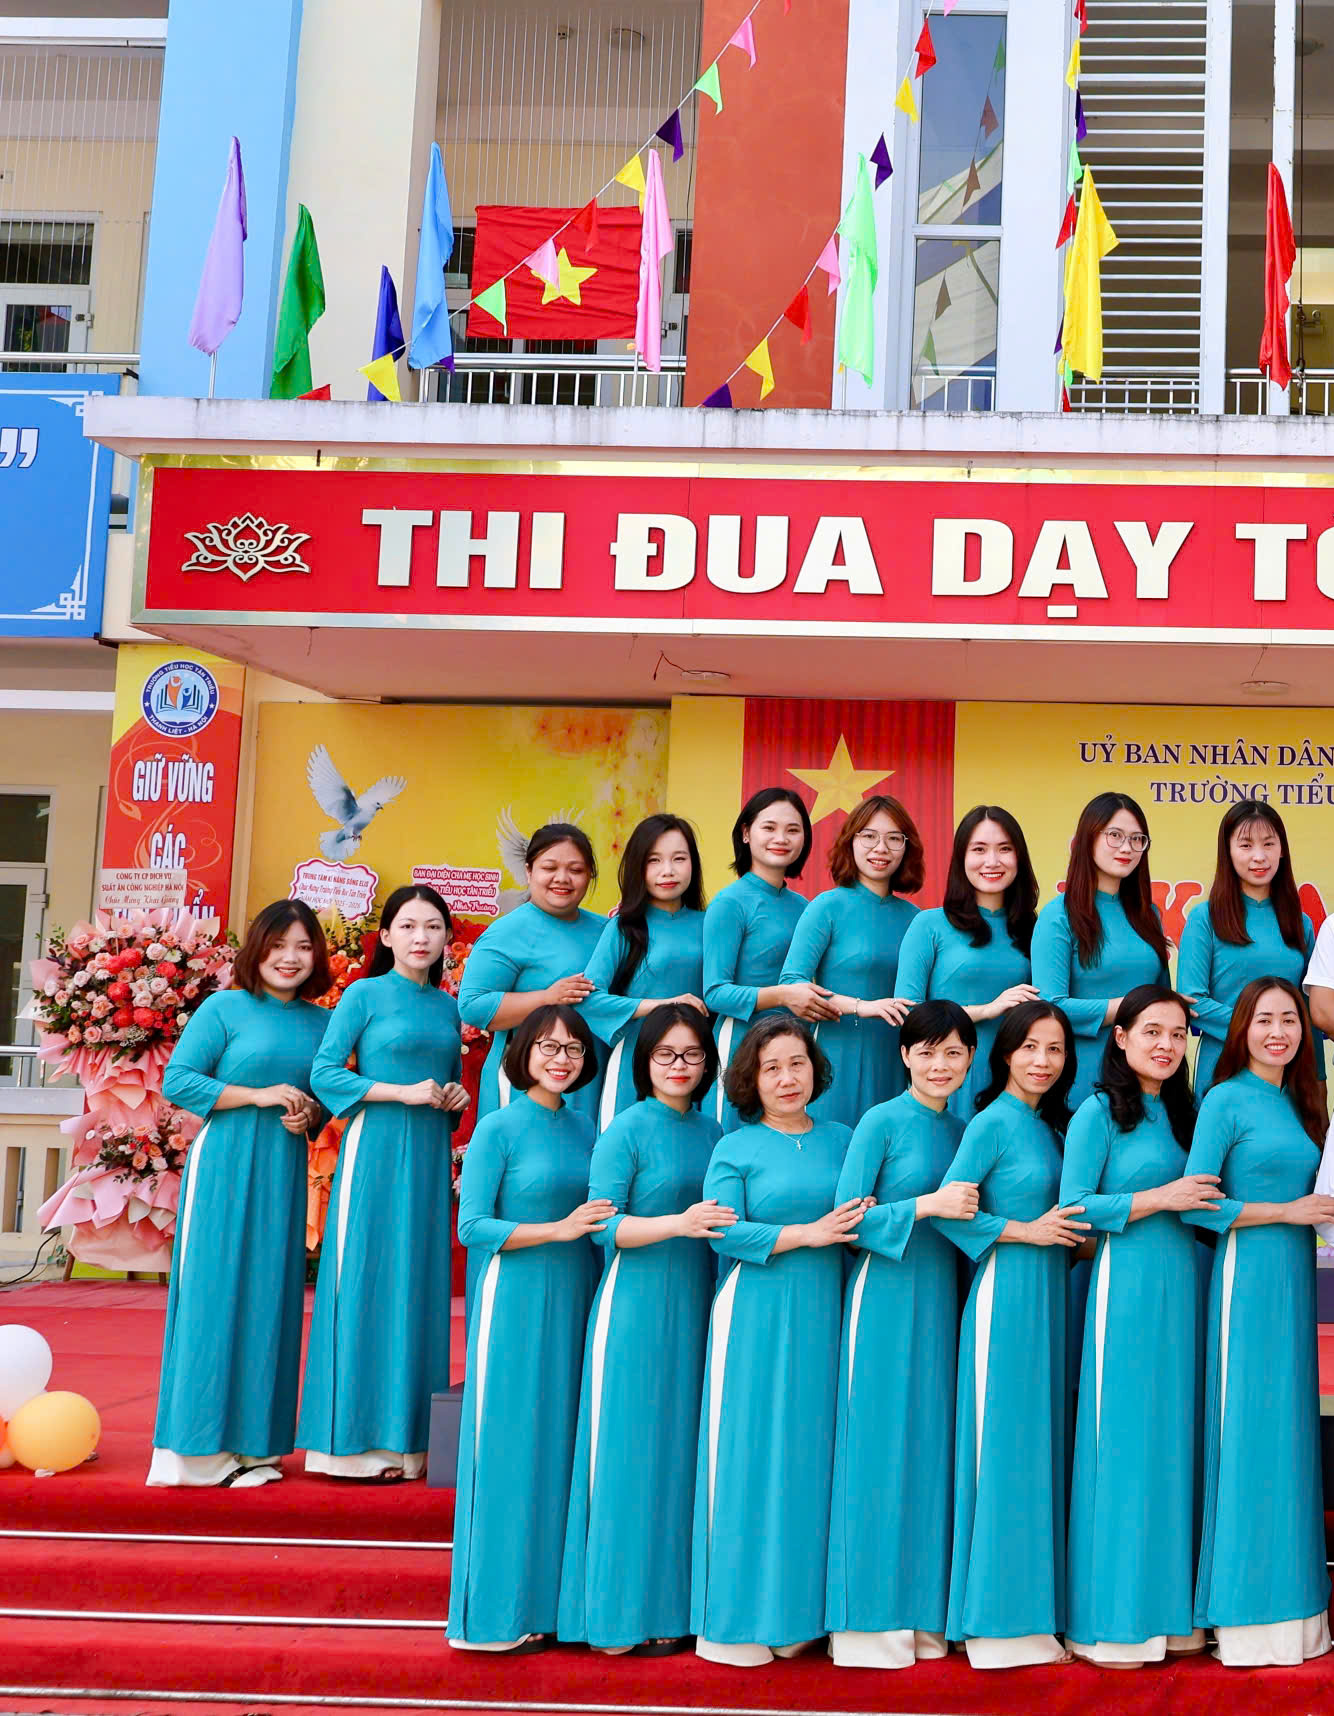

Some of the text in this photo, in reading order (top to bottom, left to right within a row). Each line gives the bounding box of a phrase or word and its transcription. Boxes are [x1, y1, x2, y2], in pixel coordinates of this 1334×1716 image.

[362, 508, 565, 589] THI
[610, 513, 884, 595] ĐUA
[931, 518, 1194, 617] DẠY
[149, 714, 167, 731] THANH
[1079, 734, 1116, 763] UỶ
[1124, 743, 1182, 764] BAN
[1189, 738, 1271, 766] NHÂN
[132, 753, 215, 803] GIỮ VỮNG
[1150, 775, 1270, 804] TRƯỜNG
[151, 824, 187, 869] CÁC
[116, 872, 132, 880] CÔNG
[303, 872, 317, 880] TRUNG
[413, 868, 499, 881] BAN ĐẠI DIỆN CHA MẸ HỌC SINH
[127, 883, 142, 891] CÔNG
[165, 883, 173, 891] HÀ
[453, 886, 466, 896] HỌC
[466, 885, 478, 896] TÂN
